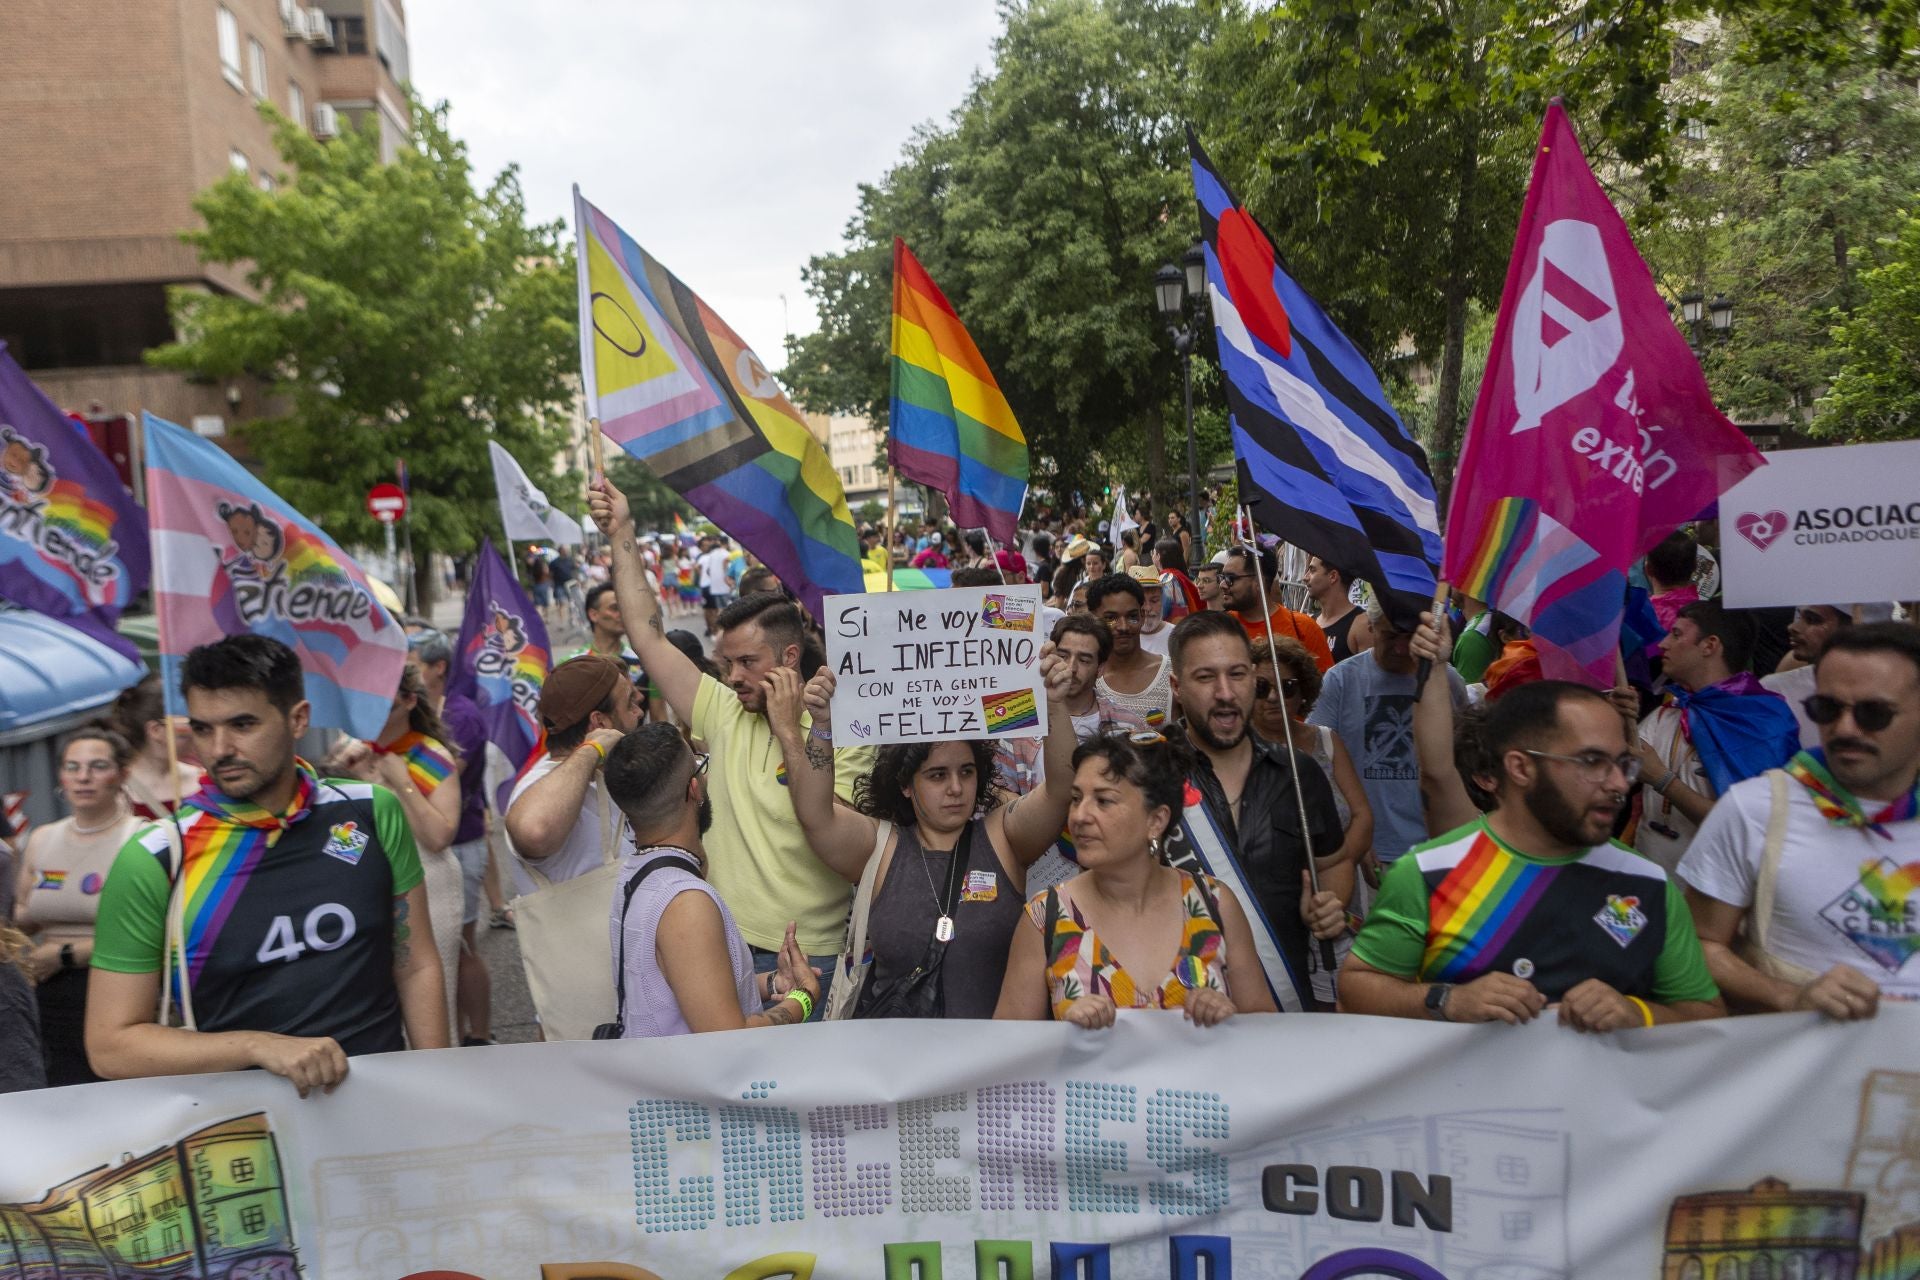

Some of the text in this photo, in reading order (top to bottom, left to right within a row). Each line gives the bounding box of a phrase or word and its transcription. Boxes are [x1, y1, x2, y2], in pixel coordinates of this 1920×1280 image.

[839, 638, 1033, 675] AL INFIERNO
[858, 676, 998, 697] CON ESTA GENTE
[903, 695, 959, 708] ME VOY
[879, 711, 980, 736] FELIZ
[256, 903, 355, 962] 40
[628, 1081, 1229, 1233] CÁCERES
[1261, 1164, 1453, 1233] CON
